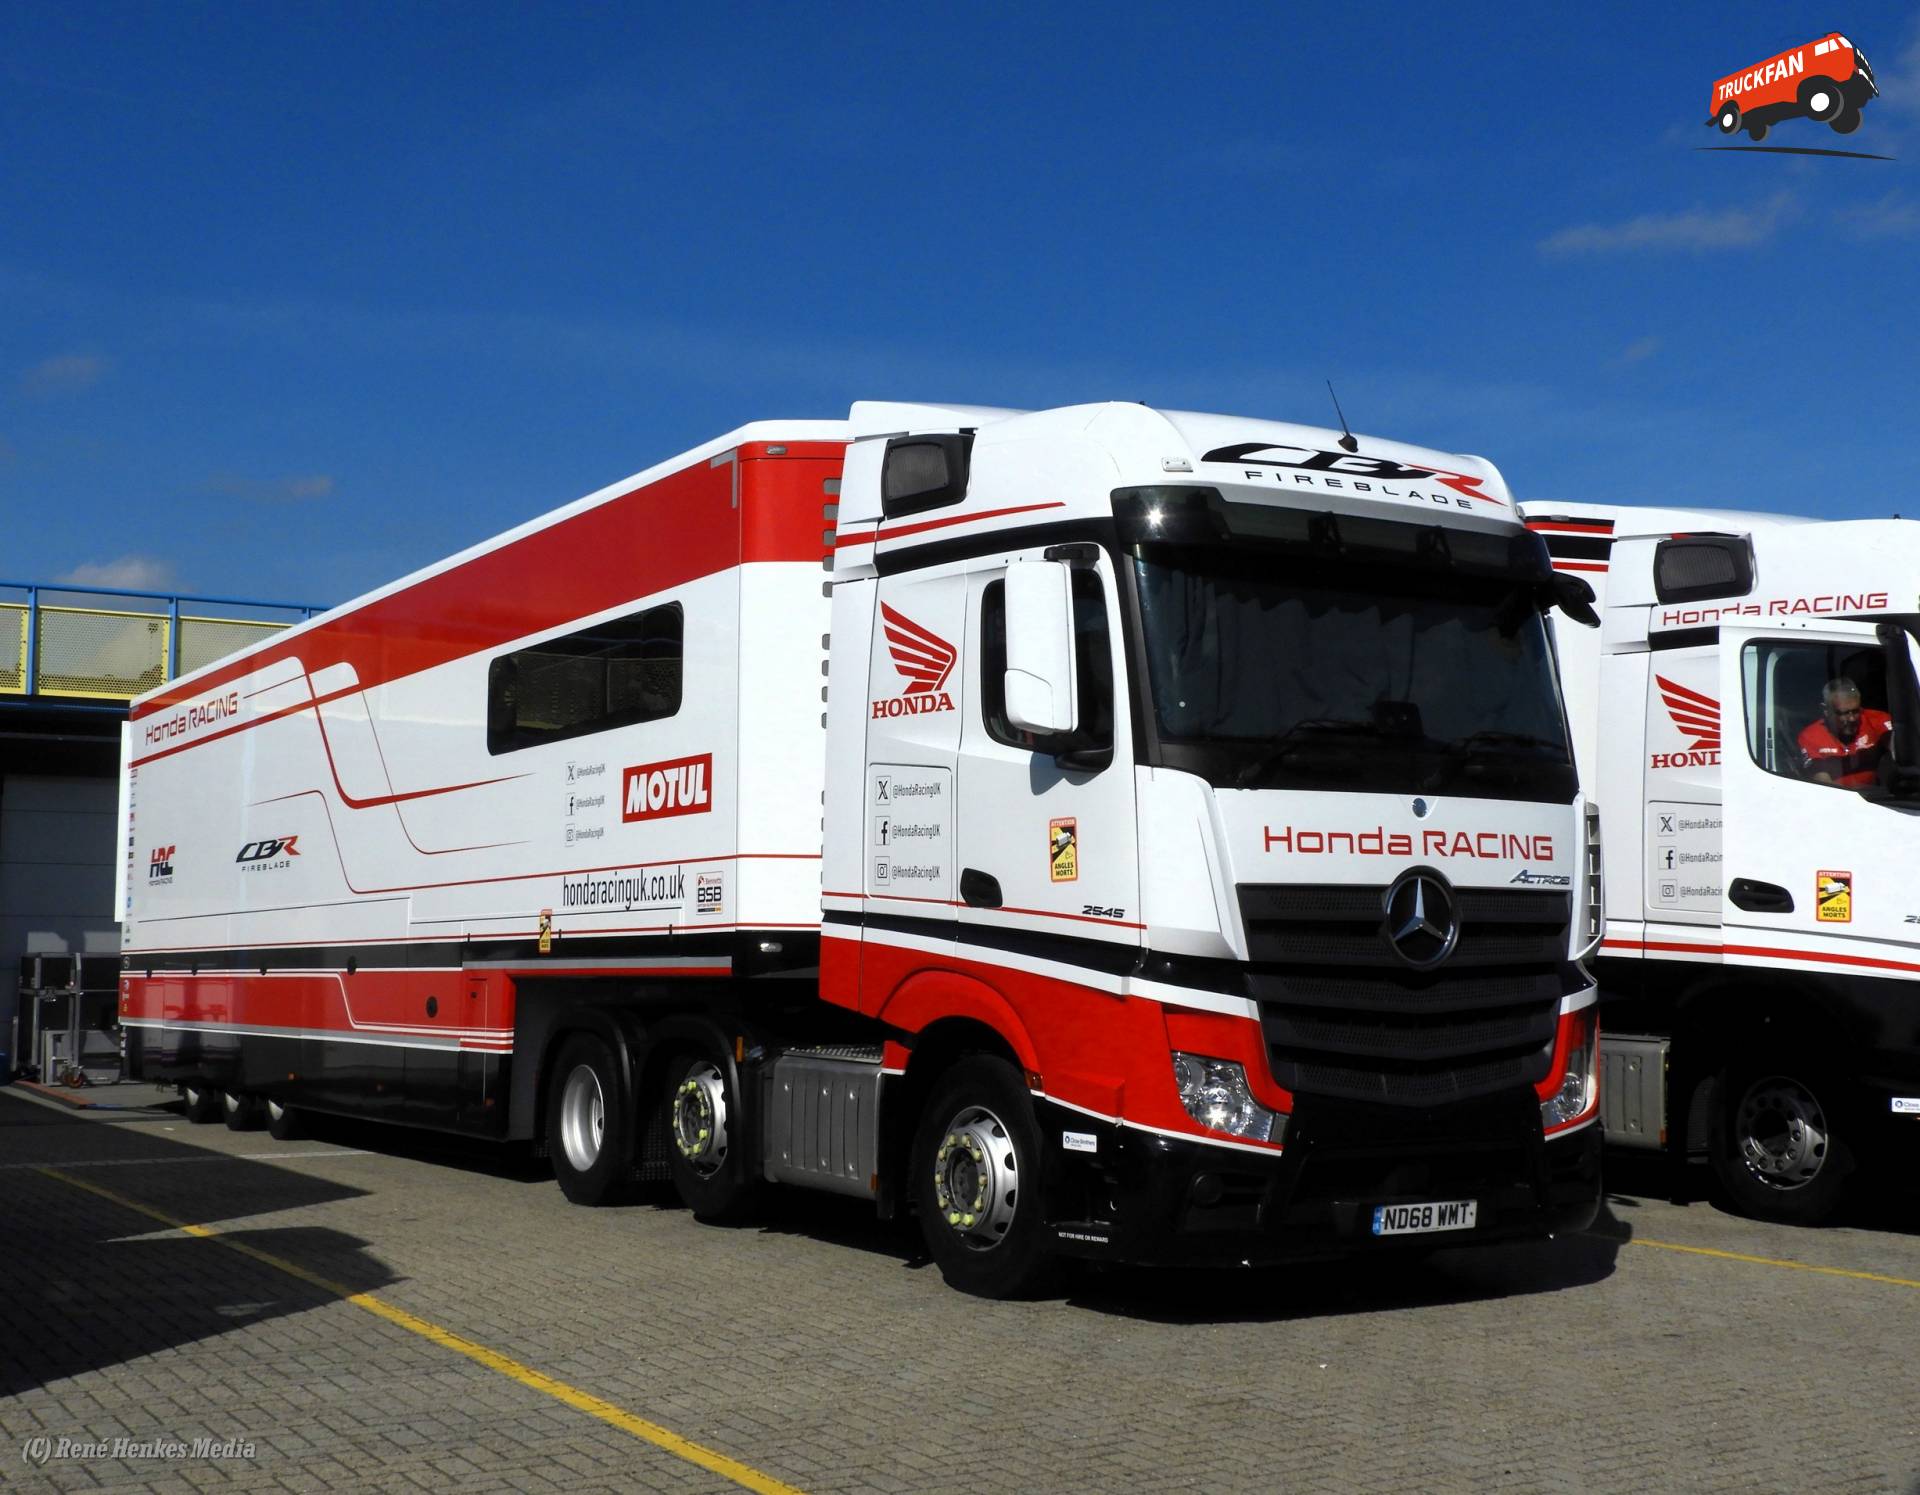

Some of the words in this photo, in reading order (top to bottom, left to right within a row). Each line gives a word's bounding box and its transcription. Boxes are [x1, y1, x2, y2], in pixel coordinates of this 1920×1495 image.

[1201, 442, 1508, 507] CBR
[1245, 470, 1473, 510] FIREBLADE
[1769, 592, 1888, 616] RACING
[872, 692, 955, 720] HONDA
[145, 713, 187, 746] Honda
[188, 692, 239, 730] RACING
[1651, 750, 1721, 769] HOND
[626, 763, 708, 815] MOTUL
[893, 782, 941, 798] @HondaRacingUK
[892, 824, 941, 840] @HondaRacingUK
[1678, 819, 1723, 831] @HondaRacin
[235, 835, 301, 863] CBR
[1264, 825, 1413, 856] Honda
[1423, 830, 1554, 862] RACING
[241, 860, 291, 872] FIREBLADE
[1678, 852, 1723, 864] @HondaRacin
[892, 865, 941, 881] @HondaRacingUK
[562, 864, 686, 911] hondaracinguk.co.uk
[697, 886, 722, 903] BSB
[1082, 904, 1126, 918] 2545
[1822, 911, 1846, 919] MORTS
[1384, 1206, 1433, 1230] ND68
[1438, 1203, 1470, 1226] WMT
